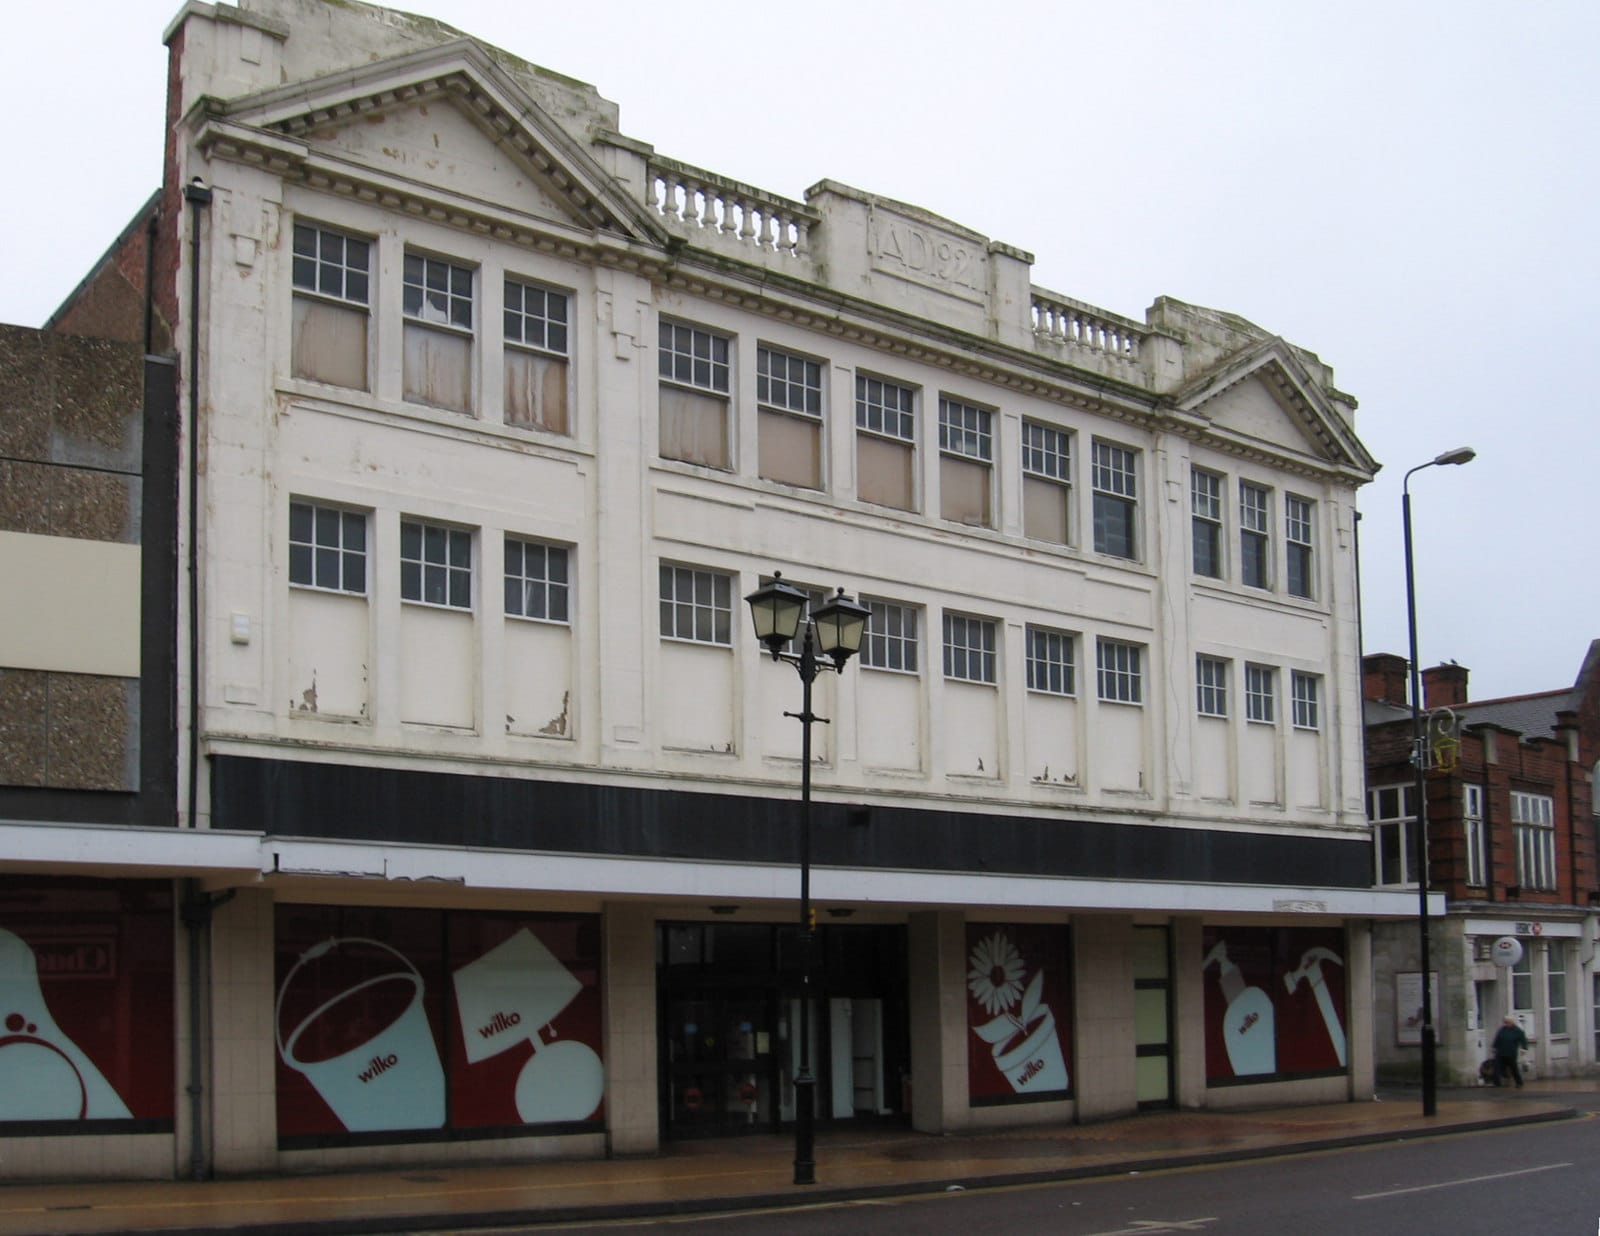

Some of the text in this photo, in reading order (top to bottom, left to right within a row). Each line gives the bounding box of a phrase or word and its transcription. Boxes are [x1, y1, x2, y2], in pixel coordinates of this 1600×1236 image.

[478, 1011, 521, 1039] wilko
[358, 1053, 398, 1083] wilko
[1017, 1059, 1044, 1086] wilko
